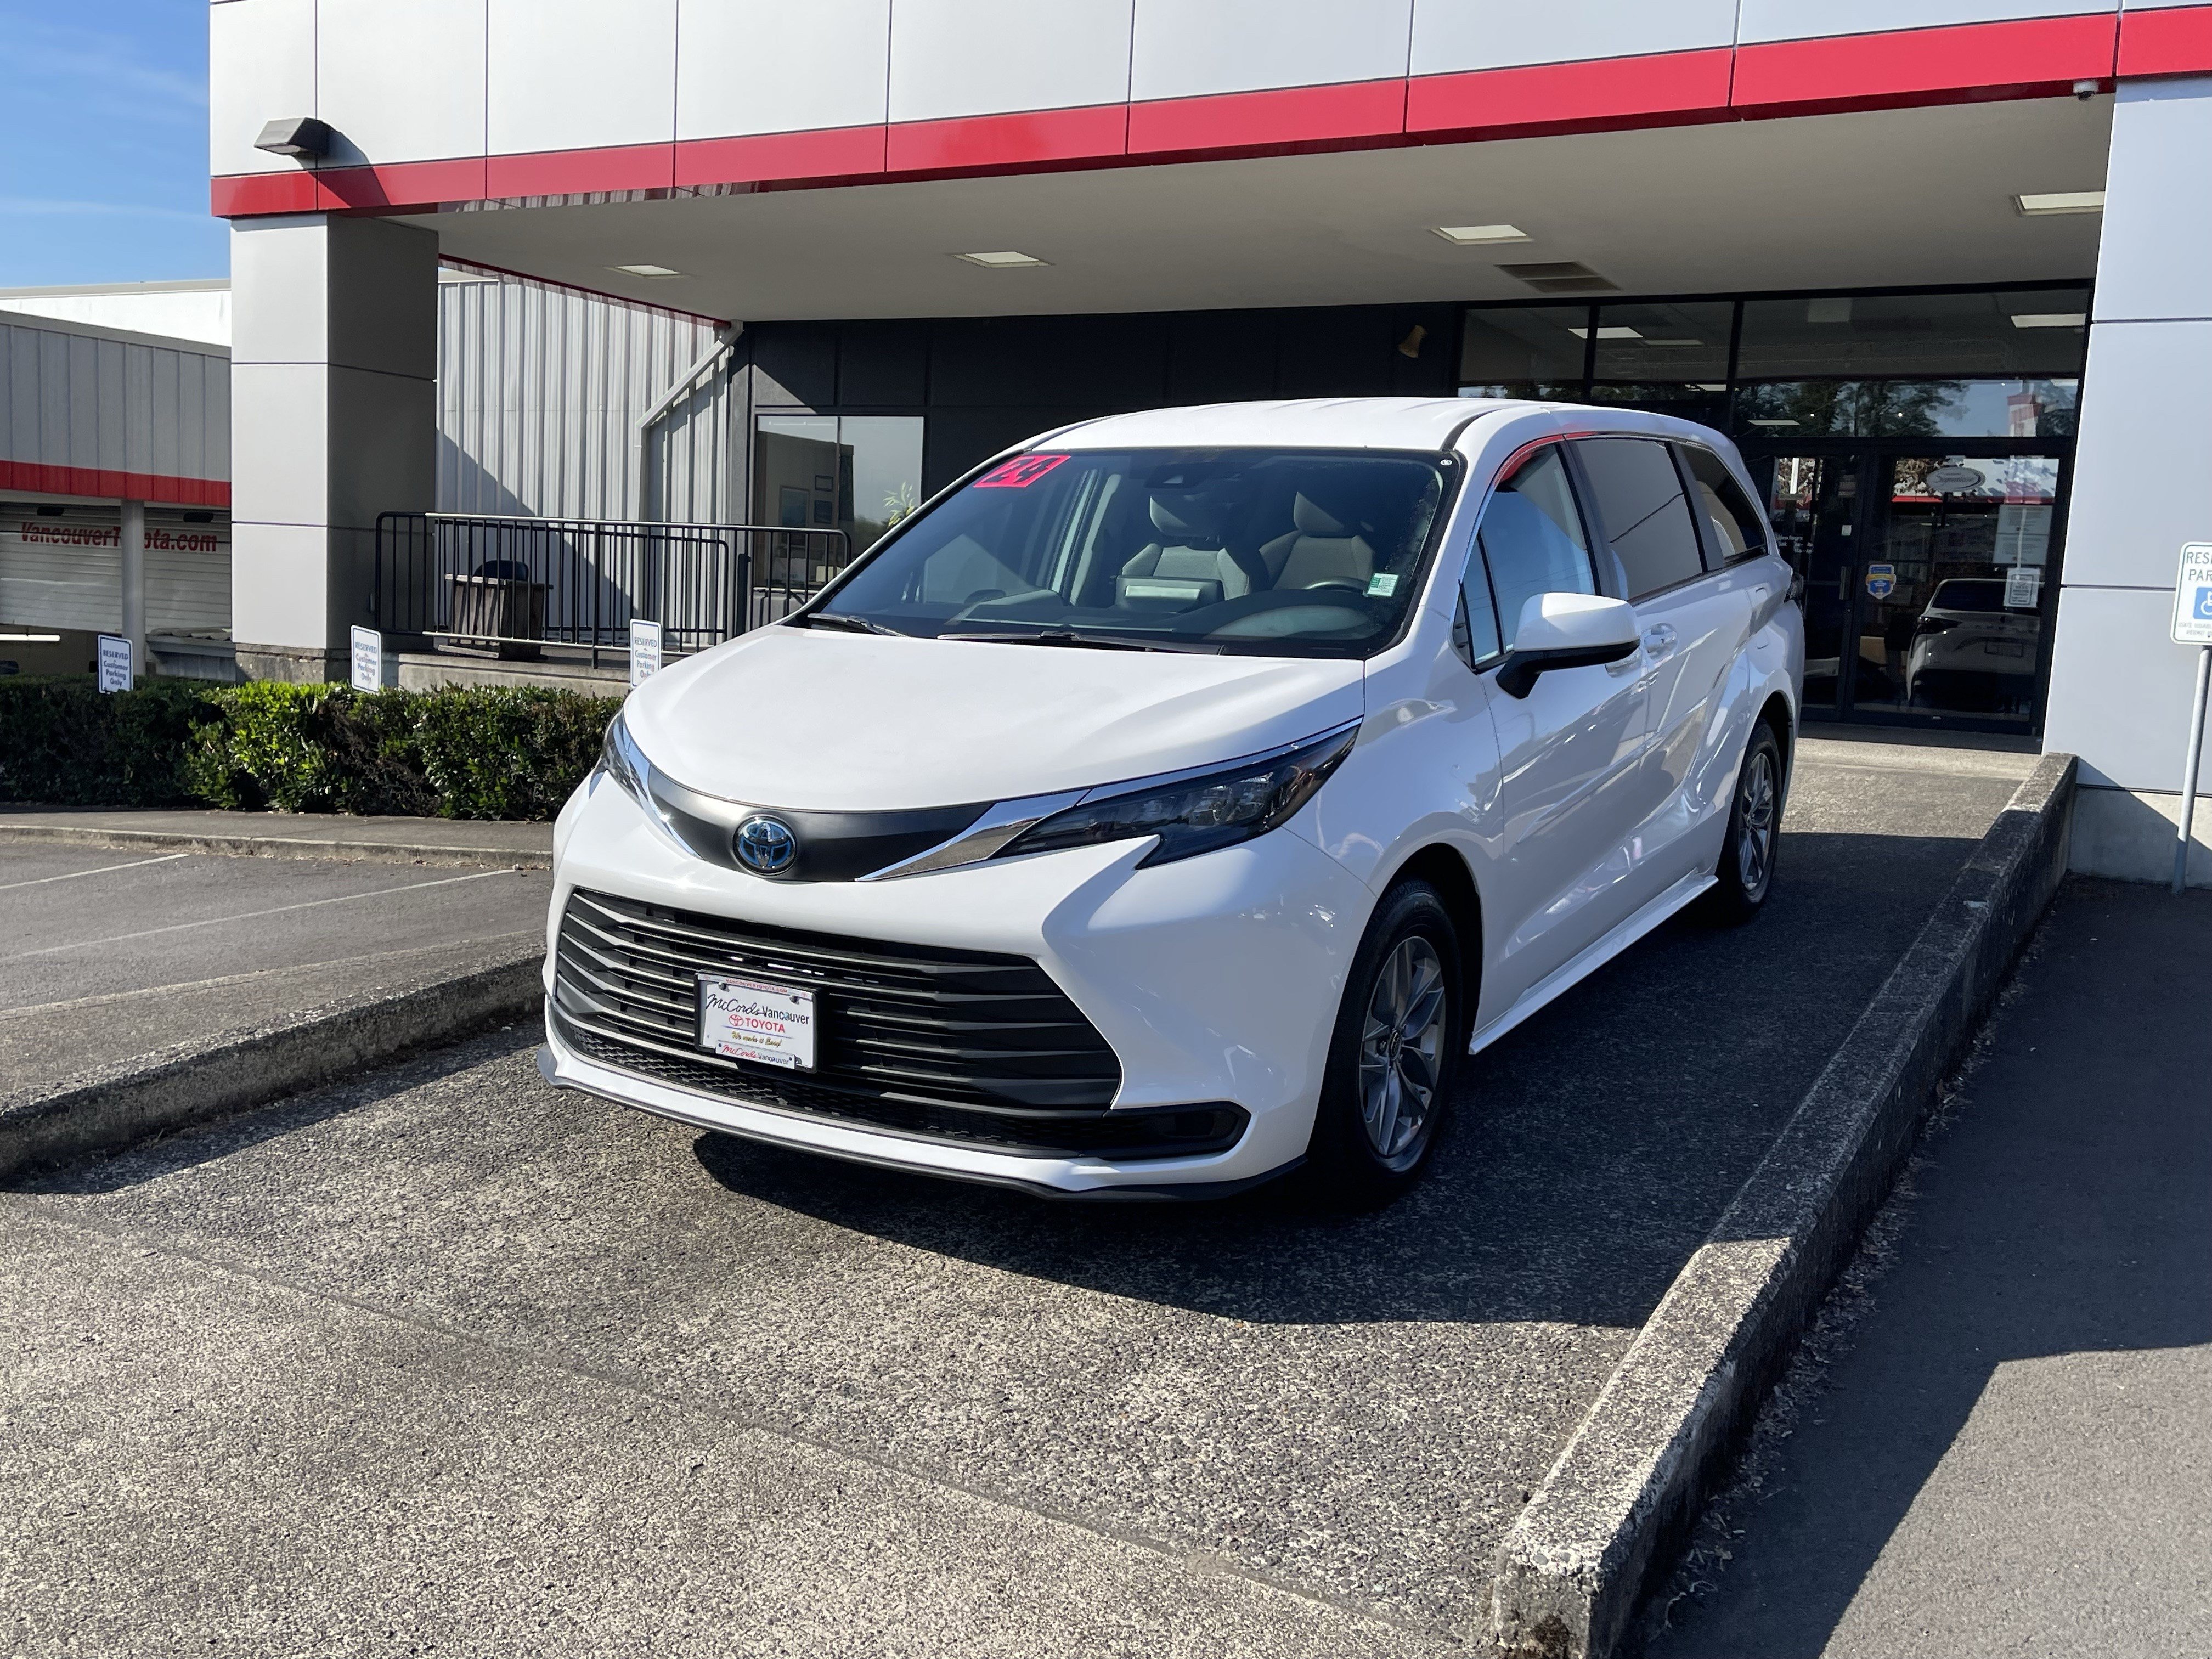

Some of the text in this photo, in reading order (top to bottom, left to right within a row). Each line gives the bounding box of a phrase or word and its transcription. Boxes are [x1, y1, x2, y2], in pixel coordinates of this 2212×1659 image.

[981, 457, 1060, 483] 24
[21, 521, 217, 552] VancouverTota.com
[2186, 552, 2212, 564] RES
[355, 641, 377, 654] RESERVED
[634, 637, 657, 647] RESERVED
[103, 649, 129, 660] RESERVED
[635, 650, 657, 661] Customer
[103, 660, 128, 670] Customer
[636, 659, 654, 673] Parking
[725, 979, 788, 994] VANCOUVERTOYOTA.COM
[745, 1017, 786, 1033] TOYOTA
